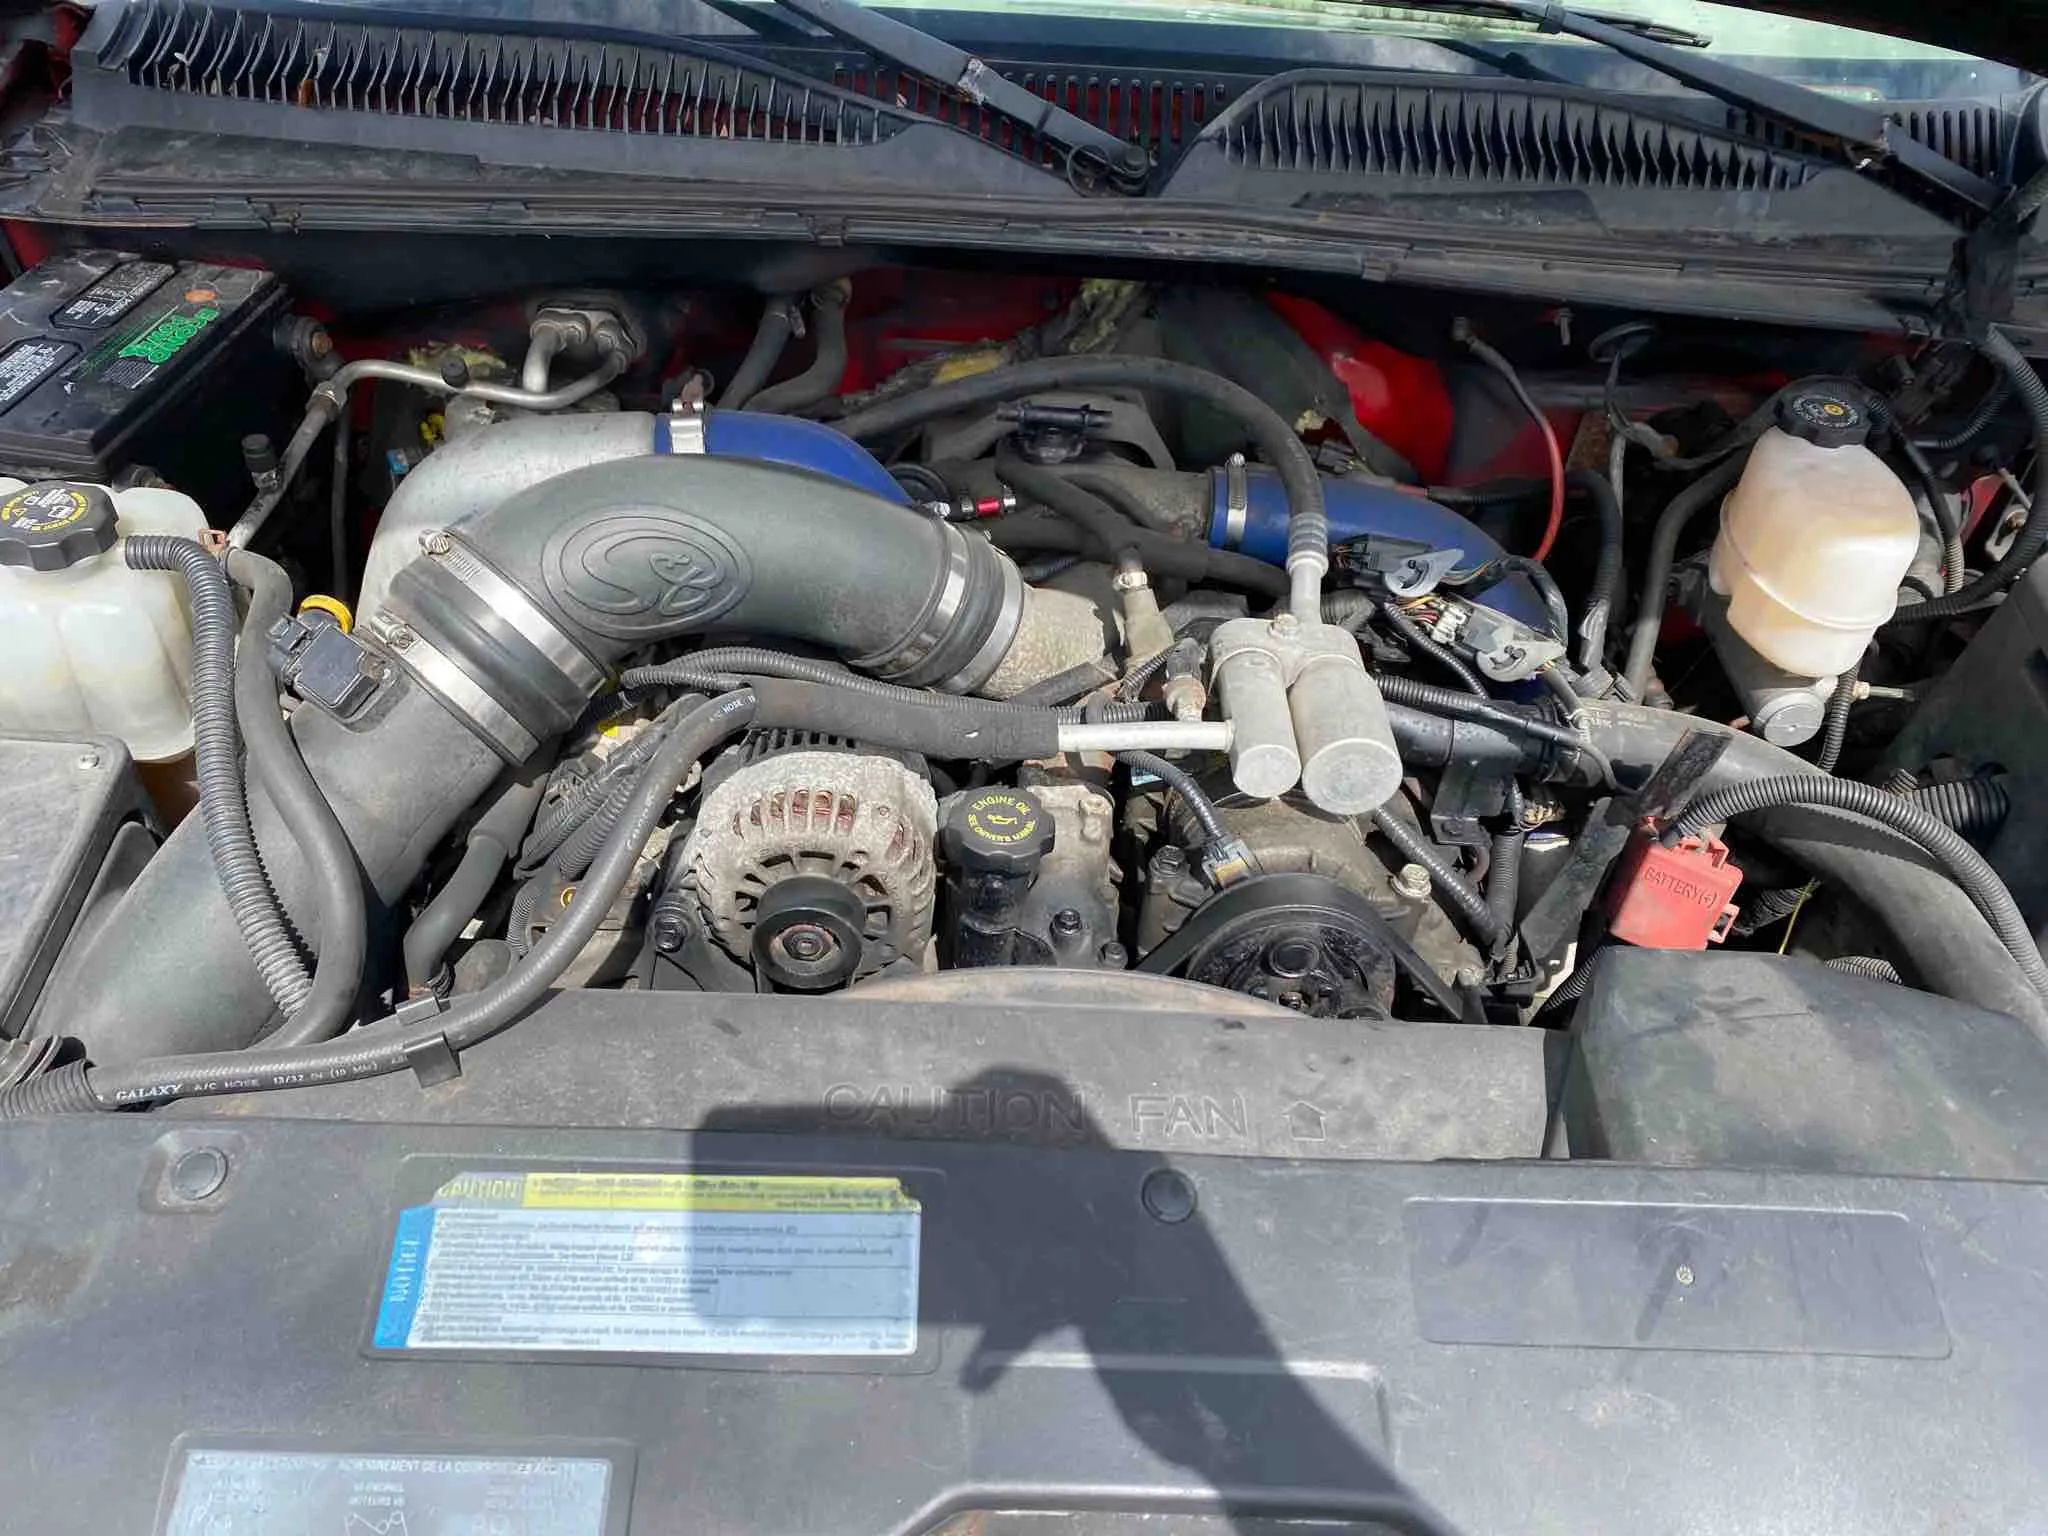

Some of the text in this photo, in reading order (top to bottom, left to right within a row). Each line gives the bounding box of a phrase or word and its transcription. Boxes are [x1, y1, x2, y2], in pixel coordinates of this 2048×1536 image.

[972, 795, 1031, 816] ENGINE OIL
[116, 1083, 183, 1101] GALAXY
[194, 1082, 217, 1092] A/C
[822, 1082, 1248, 1138] CAUTION FAN
[438, 1178, 517, 1199] CAUTION
